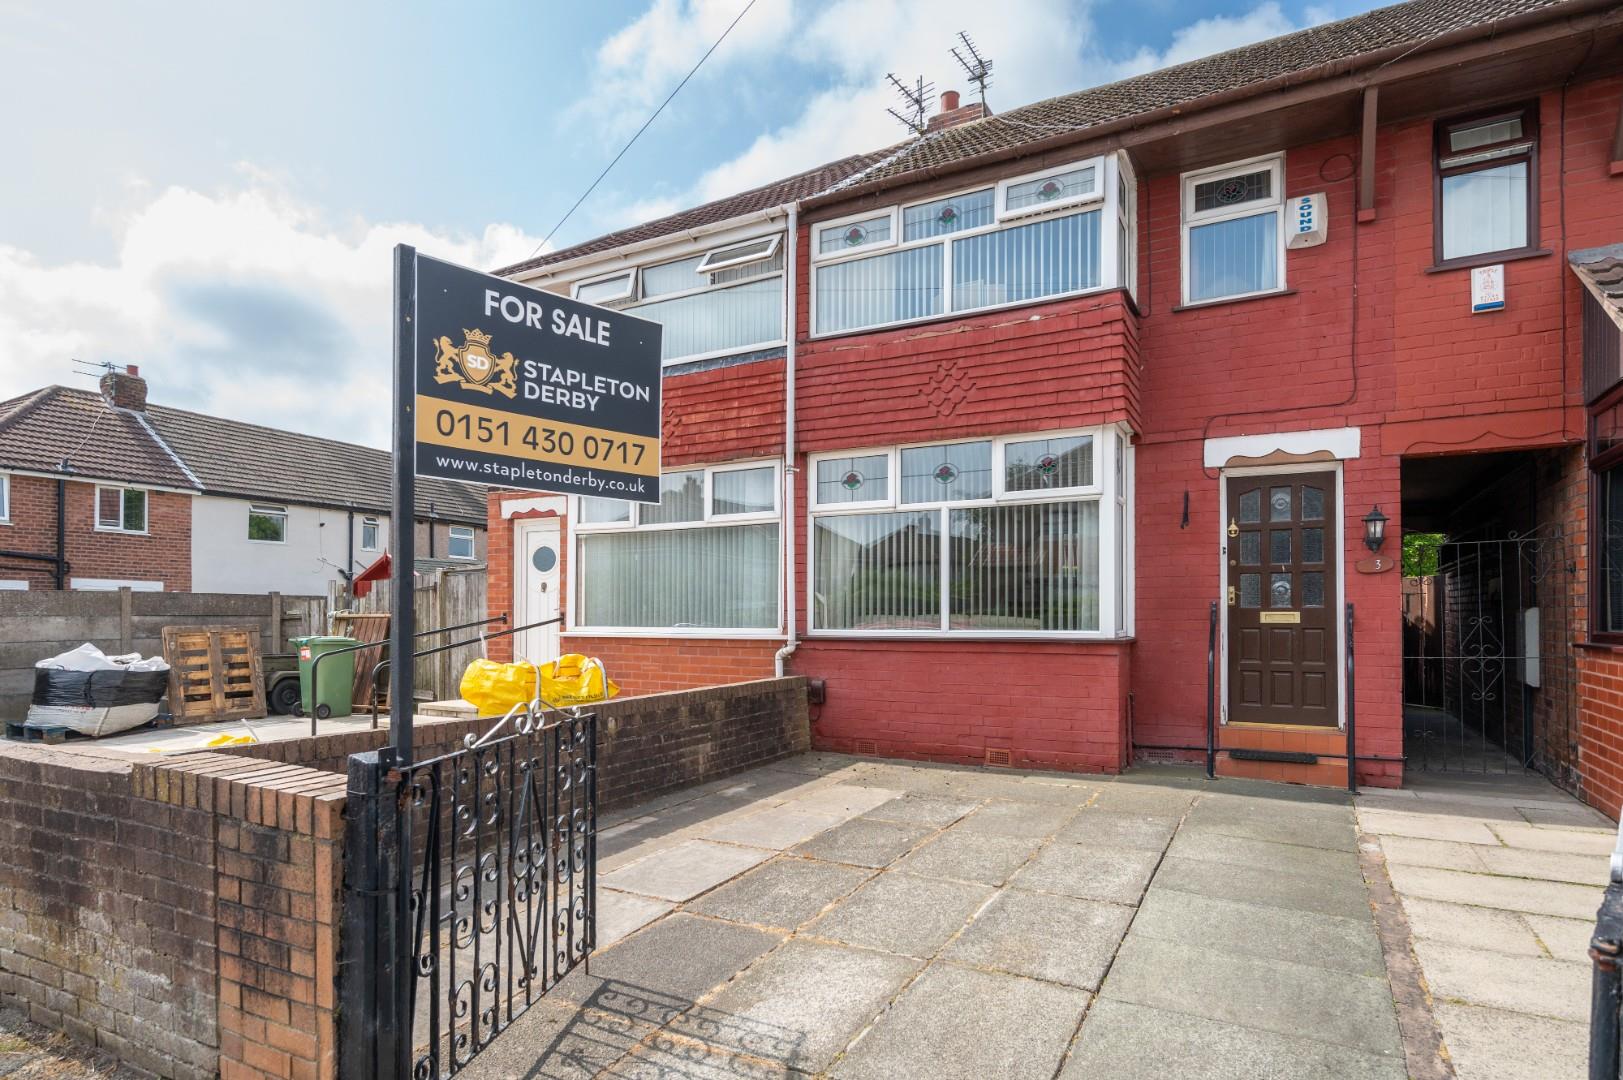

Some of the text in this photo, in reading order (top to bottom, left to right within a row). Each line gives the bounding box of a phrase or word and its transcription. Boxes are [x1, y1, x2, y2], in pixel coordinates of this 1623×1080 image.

[484, 289, 611, 347] FOR SALE
[466, 354, 490, 371] SD
[523, 360, 650, 402] STAPLETON
[524, 381, 600, 411] DERBY
[436, 409, 646, 466] 0151 430 0717
[436, 456, 646, 493] www.stapletonderby.co.uk
[1375, 559, 1382, 570] 3
